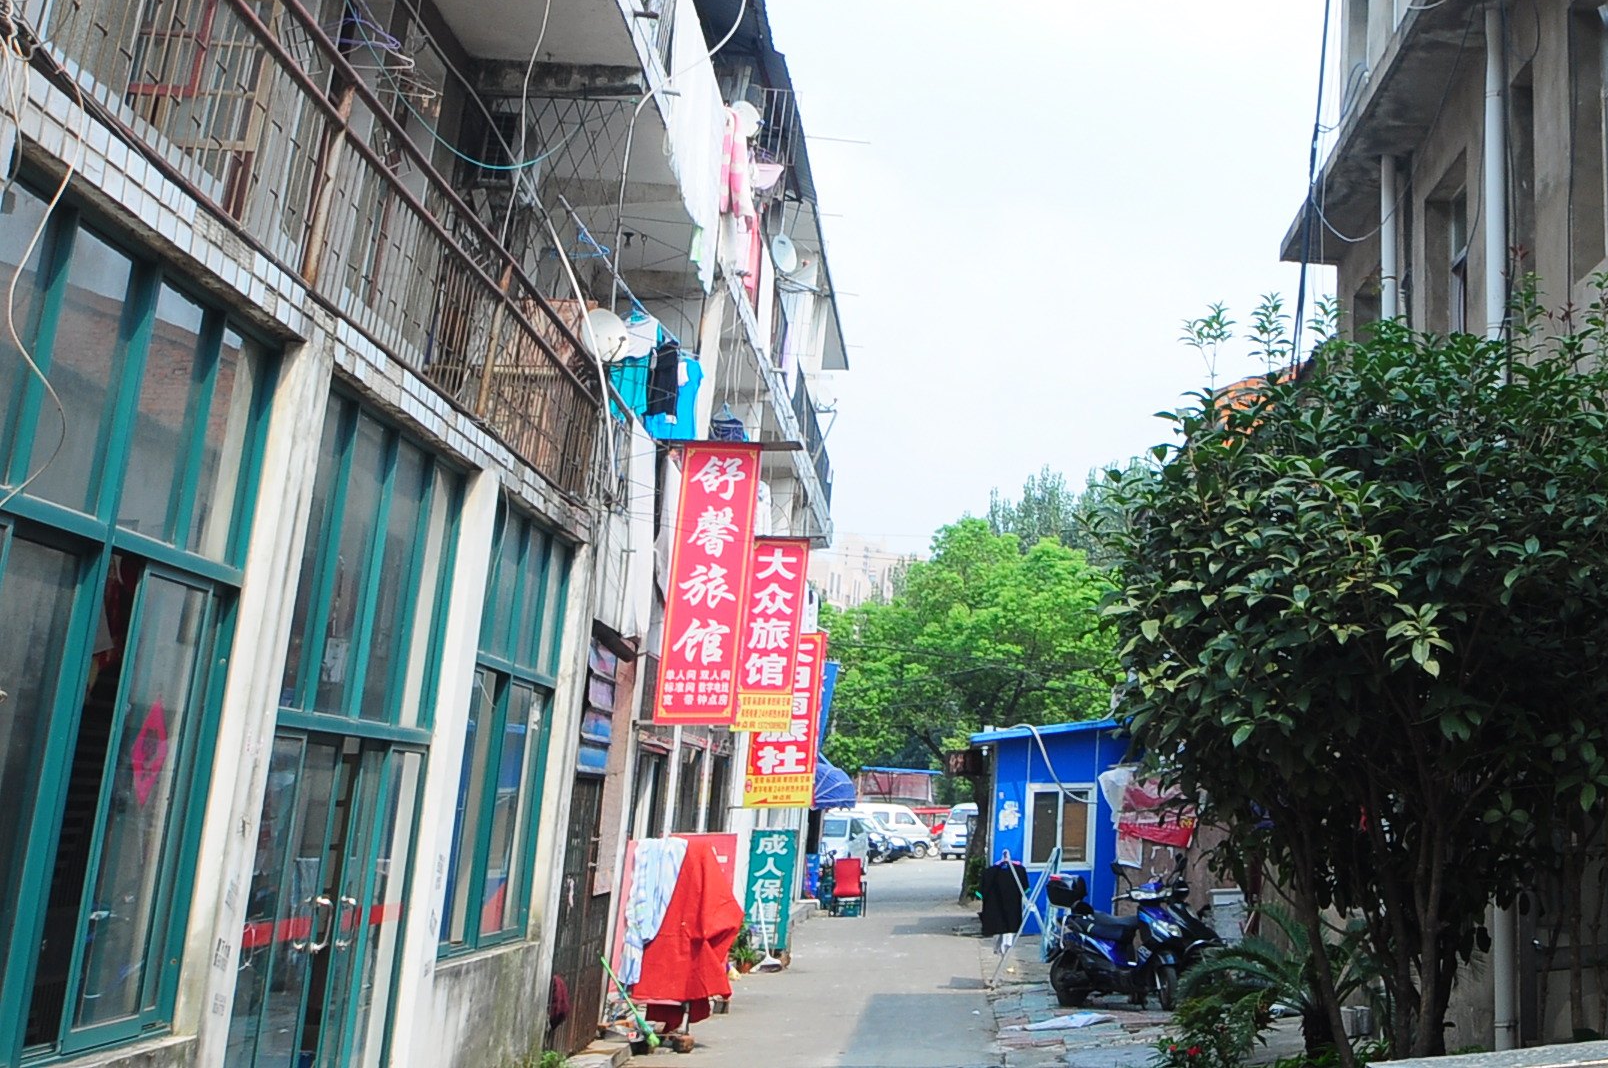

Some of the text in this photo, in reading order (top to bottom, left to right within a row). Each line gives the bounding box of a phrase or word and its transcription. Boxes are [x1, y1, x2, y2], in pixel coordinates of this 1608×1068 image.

[672, 455, 746, 666] 舒馨旅馆
[745, 548, 797, 686] 大众旅馆
